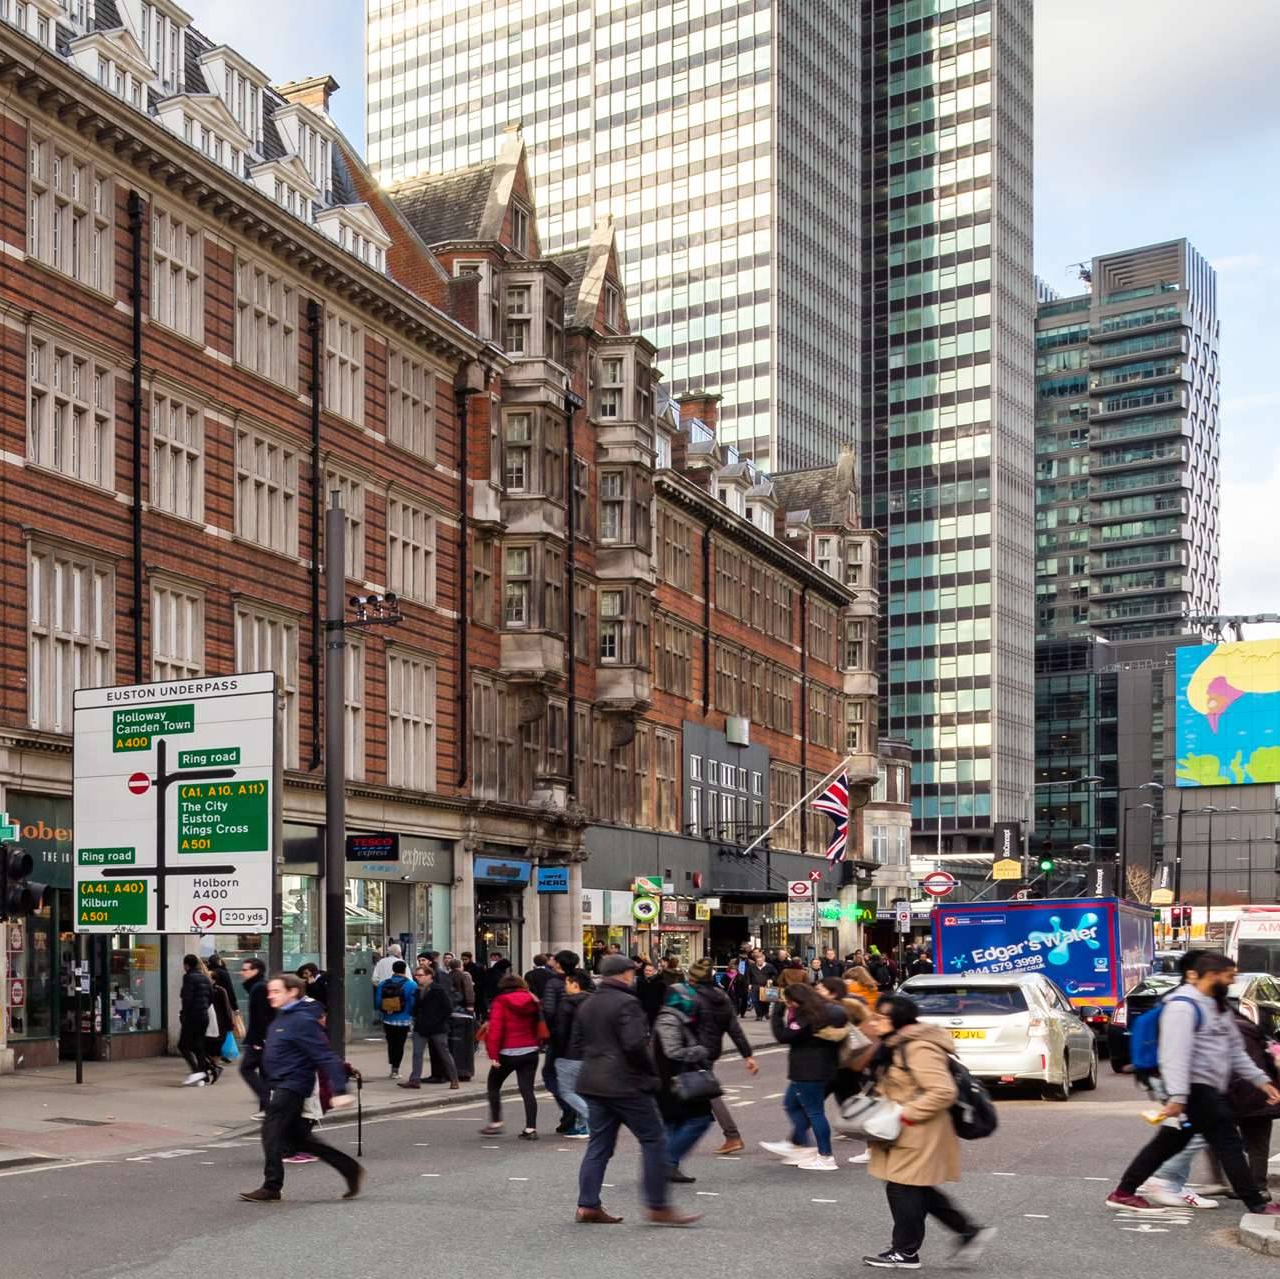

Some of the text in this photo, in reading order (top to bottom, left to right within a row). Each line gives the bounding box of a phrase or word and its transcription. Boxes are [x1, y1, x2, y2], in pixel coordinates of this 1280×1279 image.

[107, 680, 238, 702] EUSTON UNDERPASS
[116, 712, 166, 724] Holloway
[116, 720, 190, 734] Camden Town
[183, 751, 236, 765] Ring road
[182, 801, 228, 812] The City
[182, 813, 220, 824] Euston
[182, 824, 249, 836] Kings Cross
[352, 838, 393, 846] TESCO
[82, 852, 132, 863] Ring road
[357, 848, 387, 858] express
[402, 847, 435, 872] express
[193, 878, 238, 888] Holborn
[82, 898, 118, 908] Kilburn
[247, 912, 263, 922] yds
[972, 926, 1098, 964] Edgar's Water
[991, 962, 1012, 973] 579
[1014, 955, 1043, 968] 3999
